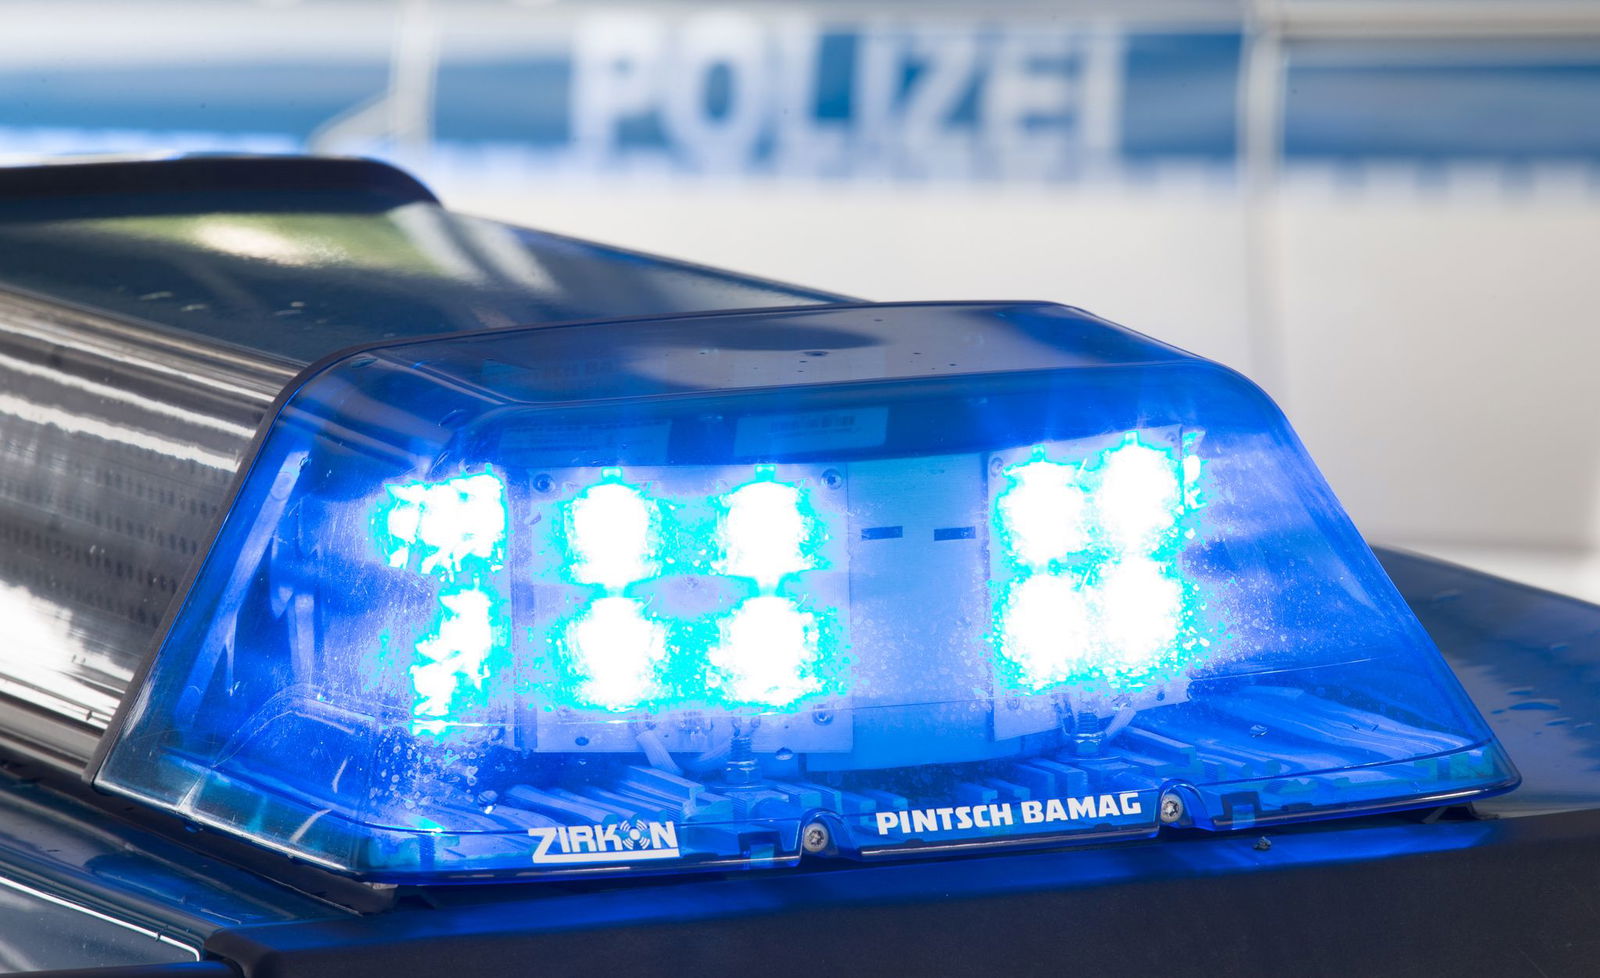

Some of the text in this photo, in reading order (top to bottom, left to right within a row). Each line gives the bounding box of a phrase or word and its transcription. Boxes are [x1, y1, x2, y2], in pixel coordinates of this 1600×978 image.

[572, 14, 1123, 174] POLIZEI
[877, 792, 1142, 835] PINTSCH BAMAG
[529, 820, 680, 863] ZIRKON
